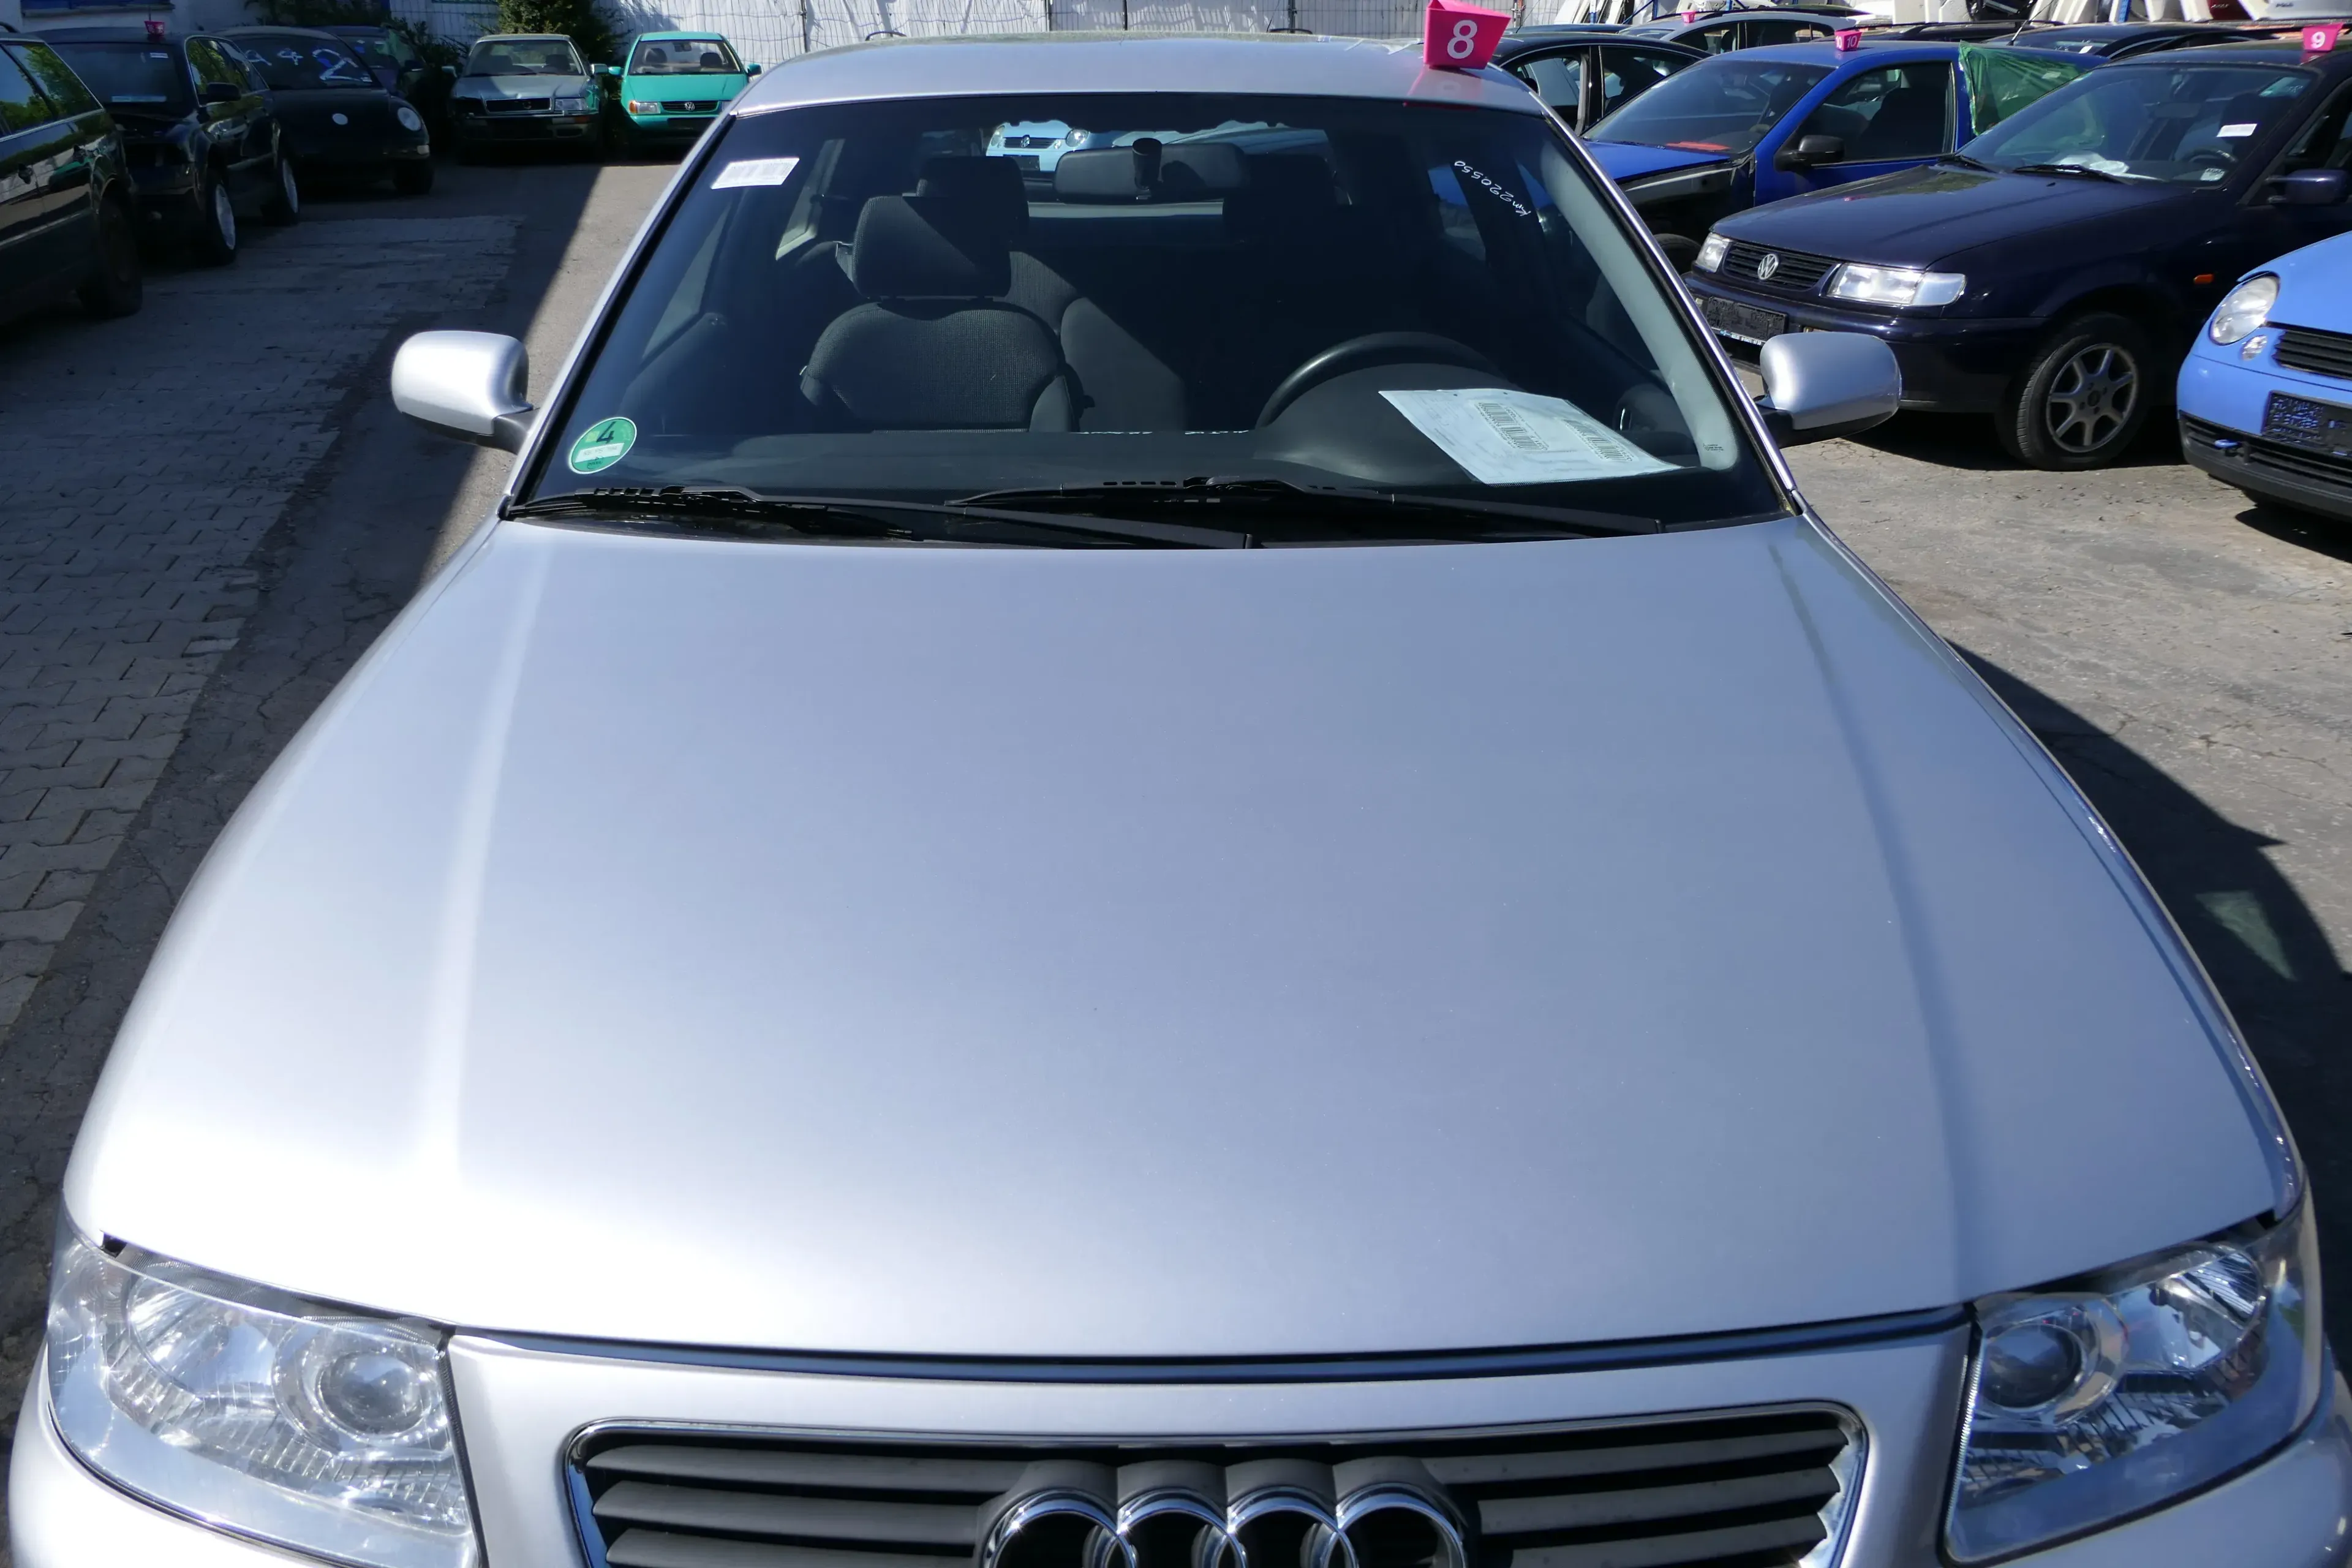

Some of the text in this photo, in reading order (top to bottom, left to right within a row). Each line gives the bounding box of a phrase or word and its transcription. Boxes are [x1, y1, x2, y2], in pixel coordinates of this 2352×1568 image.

[1447, 19, 1478, 59] 8
[1847, 35, 1858, 48] 10
[2310, 31, 2326, 49] 9
[596, 421, 617, 444] 4
